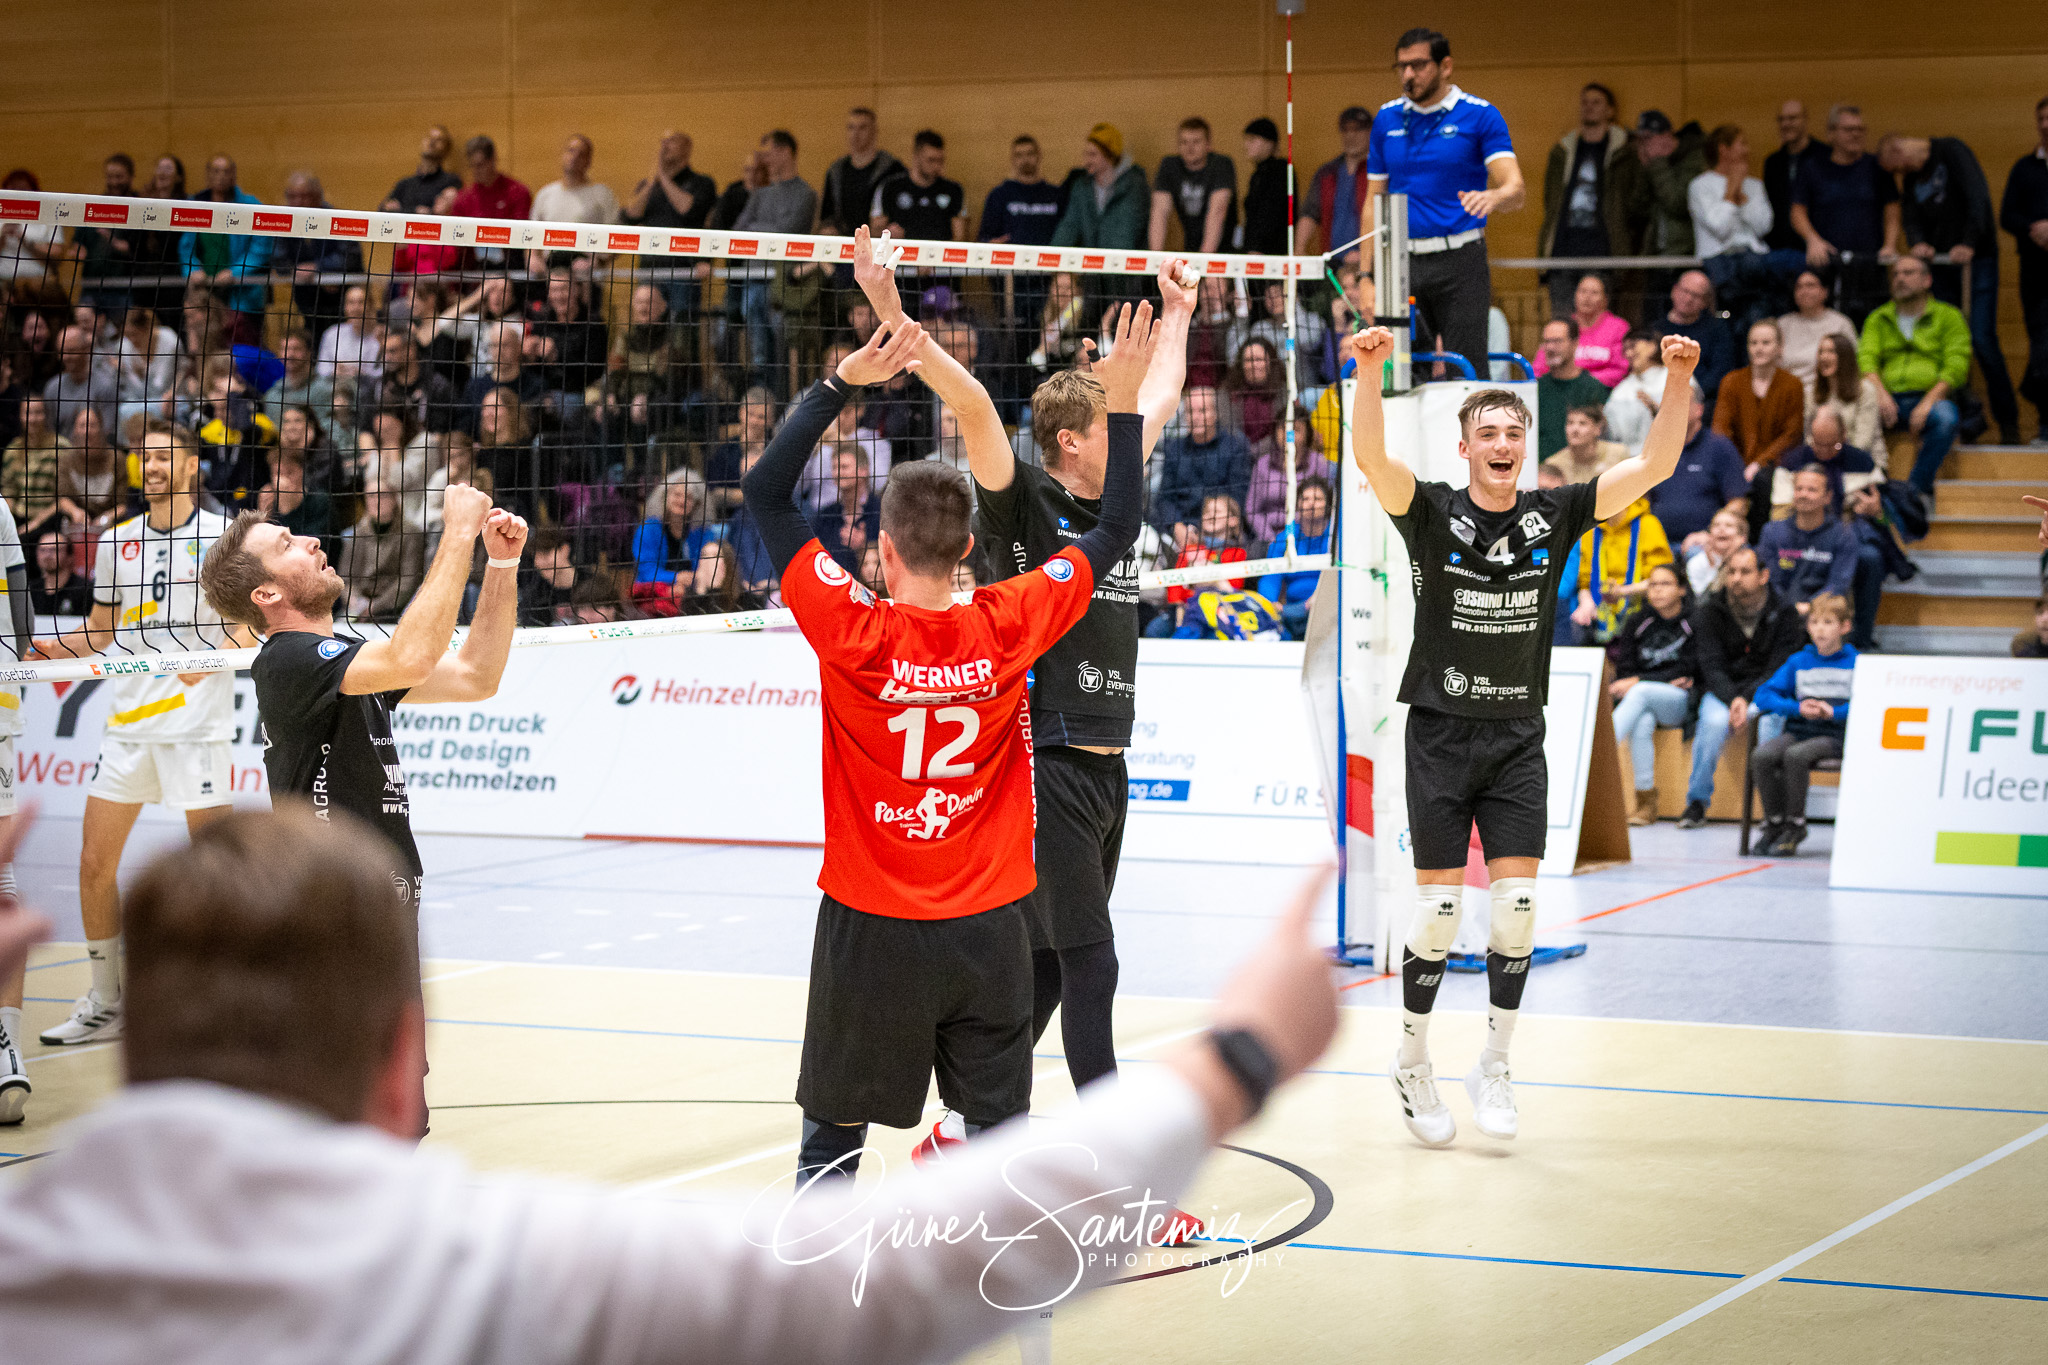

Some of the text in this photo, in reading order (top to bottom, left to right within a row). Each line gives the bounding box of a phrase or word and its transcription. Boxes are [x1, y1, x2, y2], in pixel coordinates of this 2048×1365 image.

[1486, 536, 1516, 566] 4
[152, 570, 167, 602] 6
[1505, 589, 1538, 608] LAMPS
[1454, 605, 1488, 617] Automotive
[1490, 609, 1514, 618] Lighted
[104, 660, 150, 674] FUCHS
[158, 656, 183, 672] Ideen
[186, 656, 228, 670] umsetzen
[892, 658, 994, 688] WERNER
[1108, 669, 1121, 680] VSL
[650, 678, 820, 706] Heinzelman
[1474, 676, 1490, 685] VSL
[1886, 672, 2024, 694] Firmengruppe
[392, 710, 546, 733] Wenn Druck
[396, 740, 432, 759] nd
[441, 740, 530, 768] Design
[887, 706, 980, 780] 12
[1126, 751, 1196, 770] eratung
[403, 768, 556, 792] rschmelzen
[874, 787, 984, 823] Pose Down
